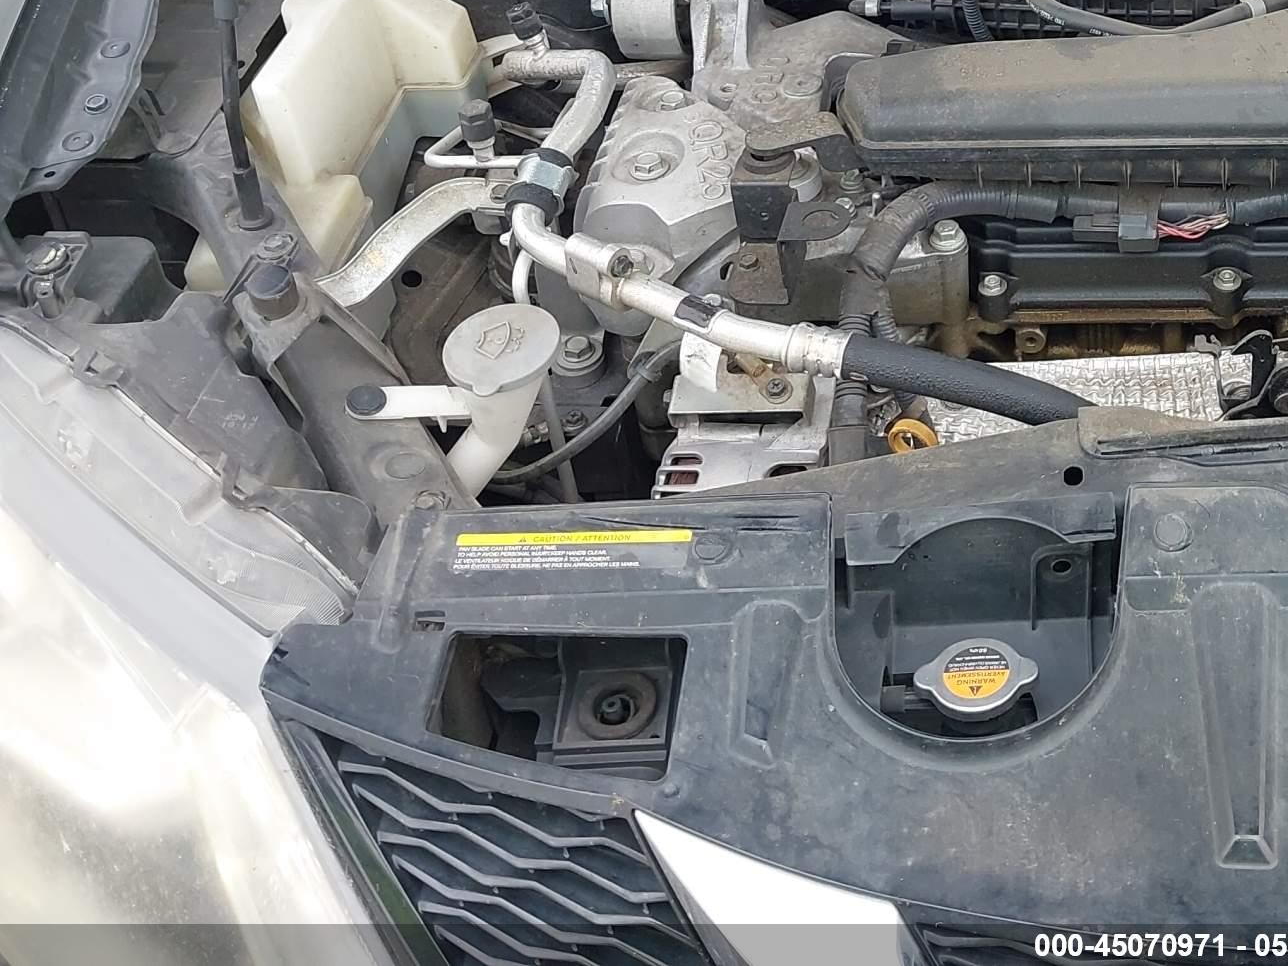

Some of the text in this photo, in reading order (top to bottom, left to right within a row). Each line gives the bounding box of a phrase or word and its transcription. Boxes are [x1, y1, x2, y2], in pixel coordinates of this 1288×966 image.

[689, 120, 733, 201] QR25
[533, 535, 573, 543] CAUTION
[582, 534, 631, 542] ATTENTION
[956, 678, 996, 686] WARNING
